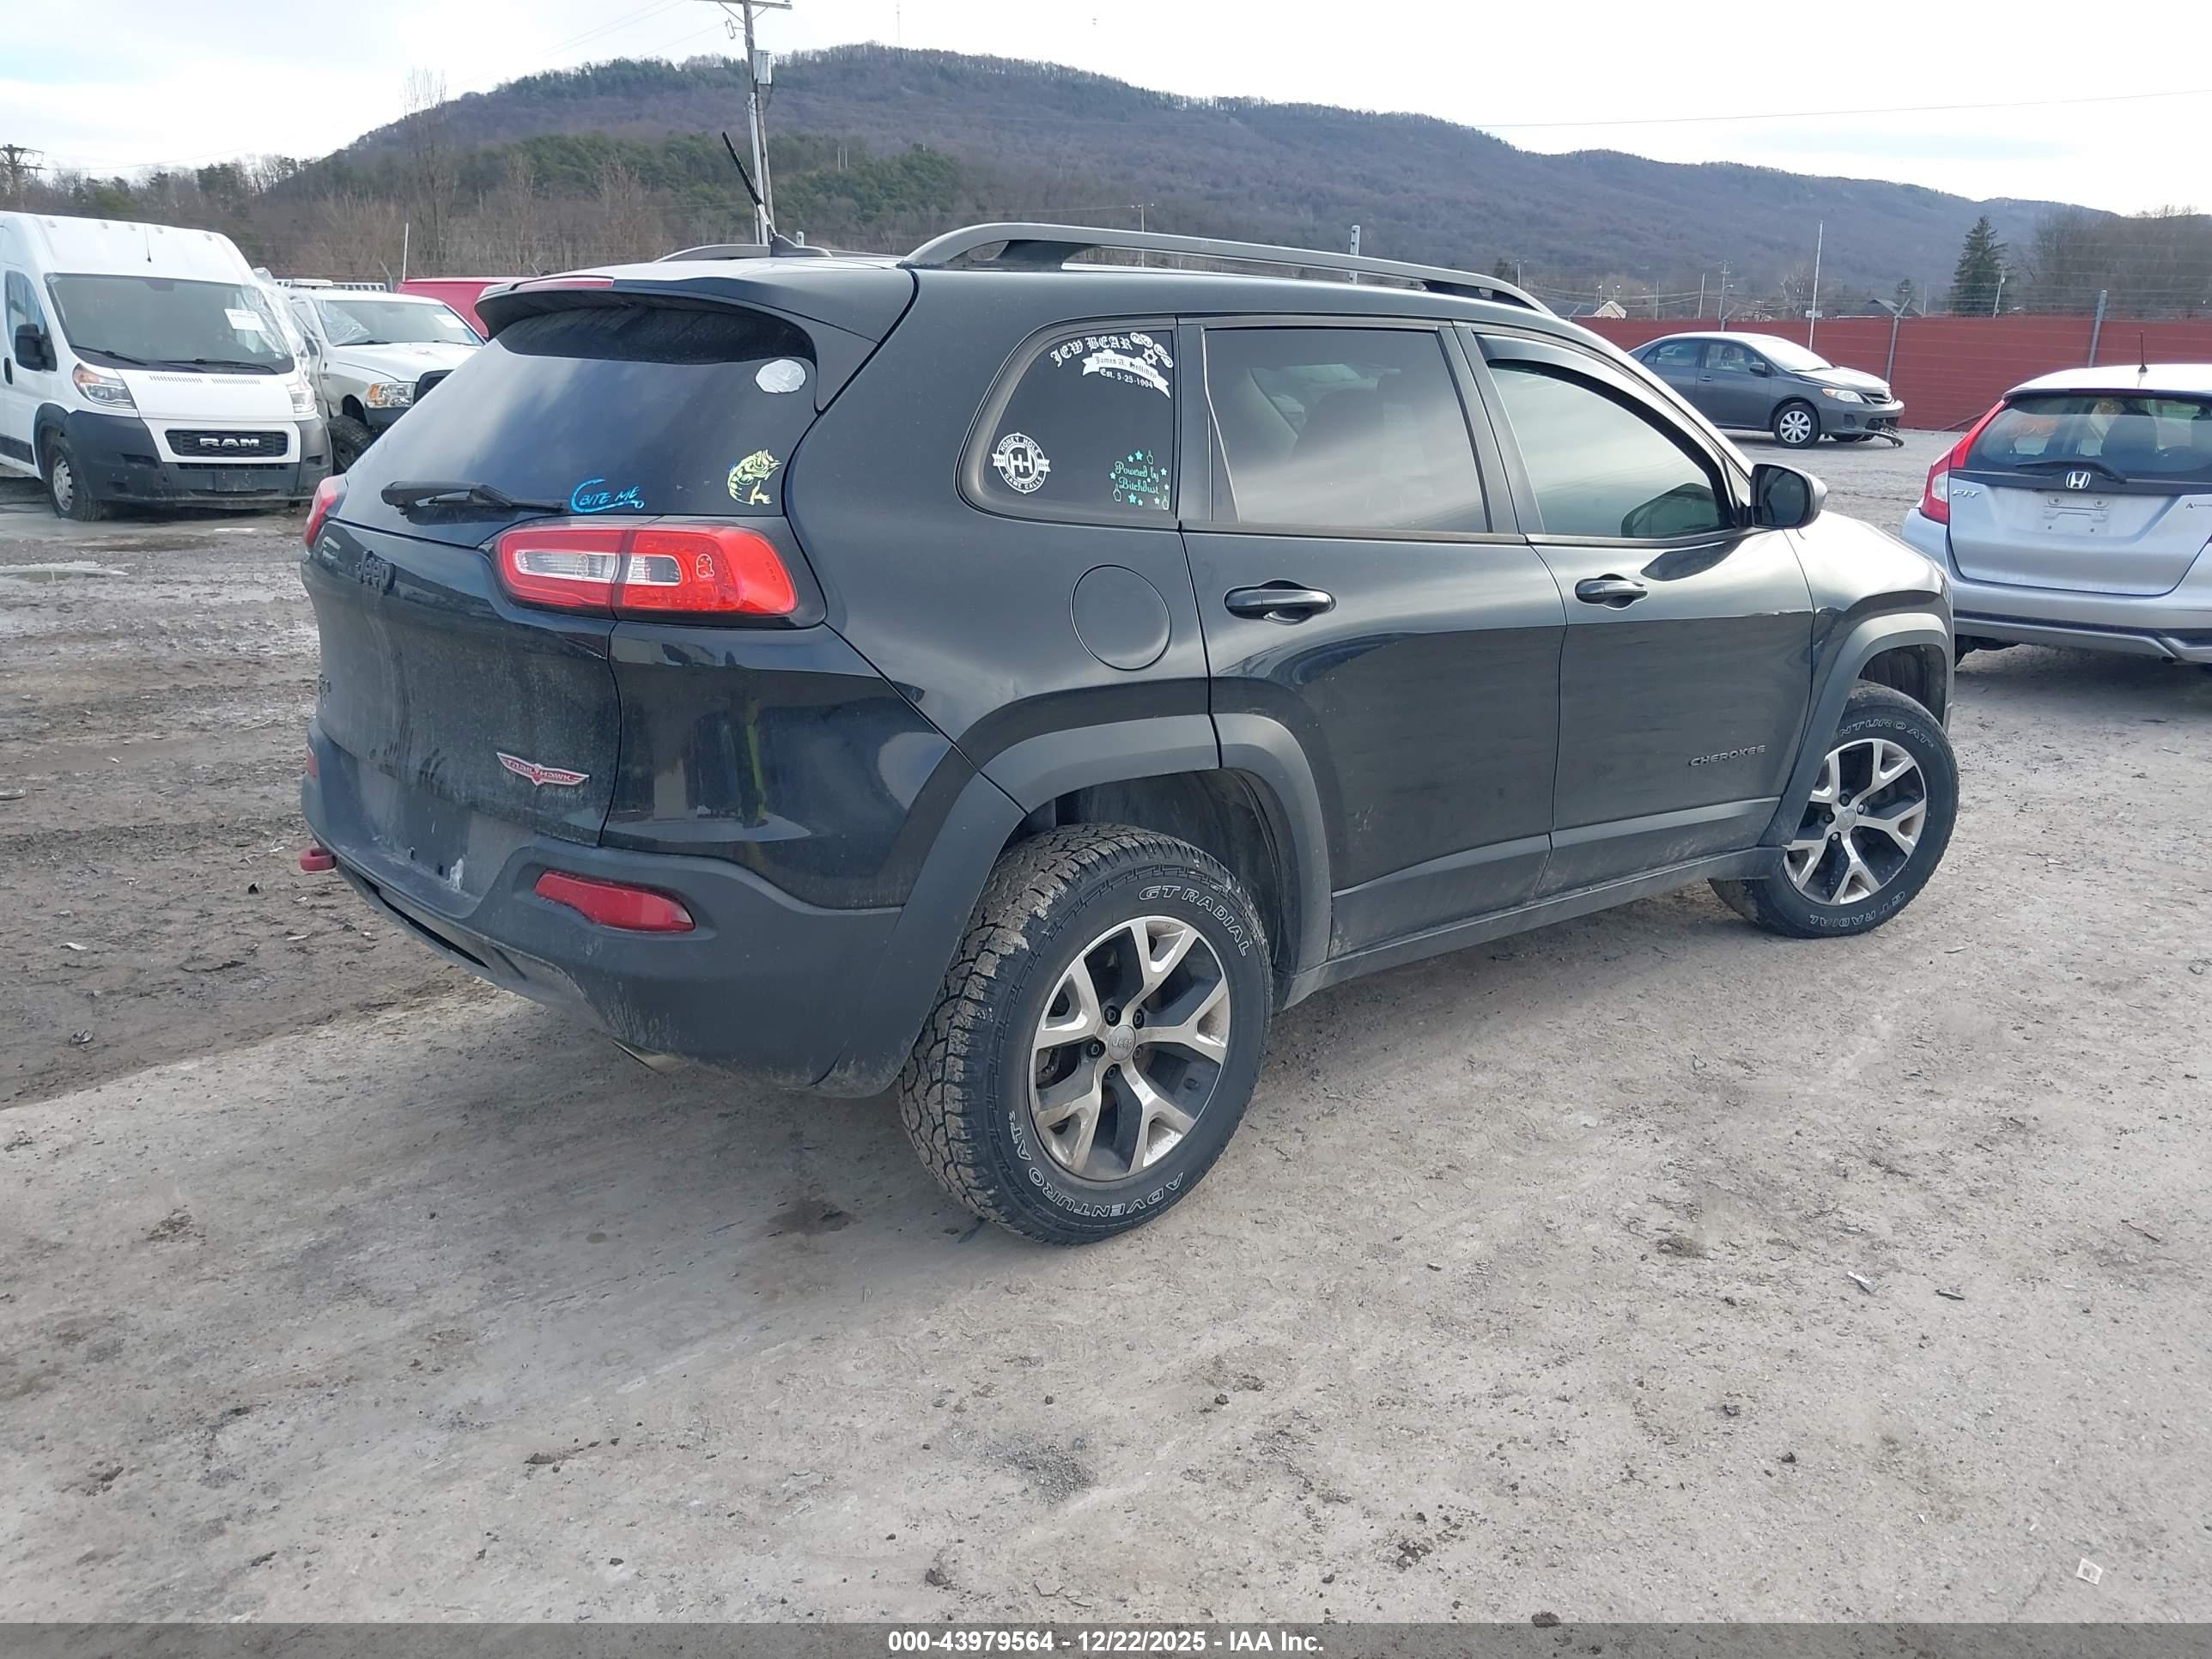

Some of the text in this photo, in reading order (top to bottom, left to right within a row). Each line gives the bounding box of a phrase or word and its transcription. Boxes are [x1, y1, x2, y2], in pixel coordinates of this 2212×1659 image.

[1050, 335, 1133, 368] JEW BEAR
[198, 436, 260, 448] RAM
[1000, 435, 1041, 455] HONEY HOLE
[1004, 472, 1043, 490] GAME CALLS
[1114, 460, 1160, 483] Powered by
[578, 485, 641, 507] BITE ME
[1951, 488, 1981, 499] FIT
[355, 550, 395, 595] Jeep
[1688, 744, 1767, 768] CHEROKEE
[1138, 884, 1252, 958] GT RADIAL
[1808, 909, 1876, 927] RADIAL
[1111, 1036, 1133, 1052] Jeep
[1027, 1166, 1185, 1219] ADVENTURO
